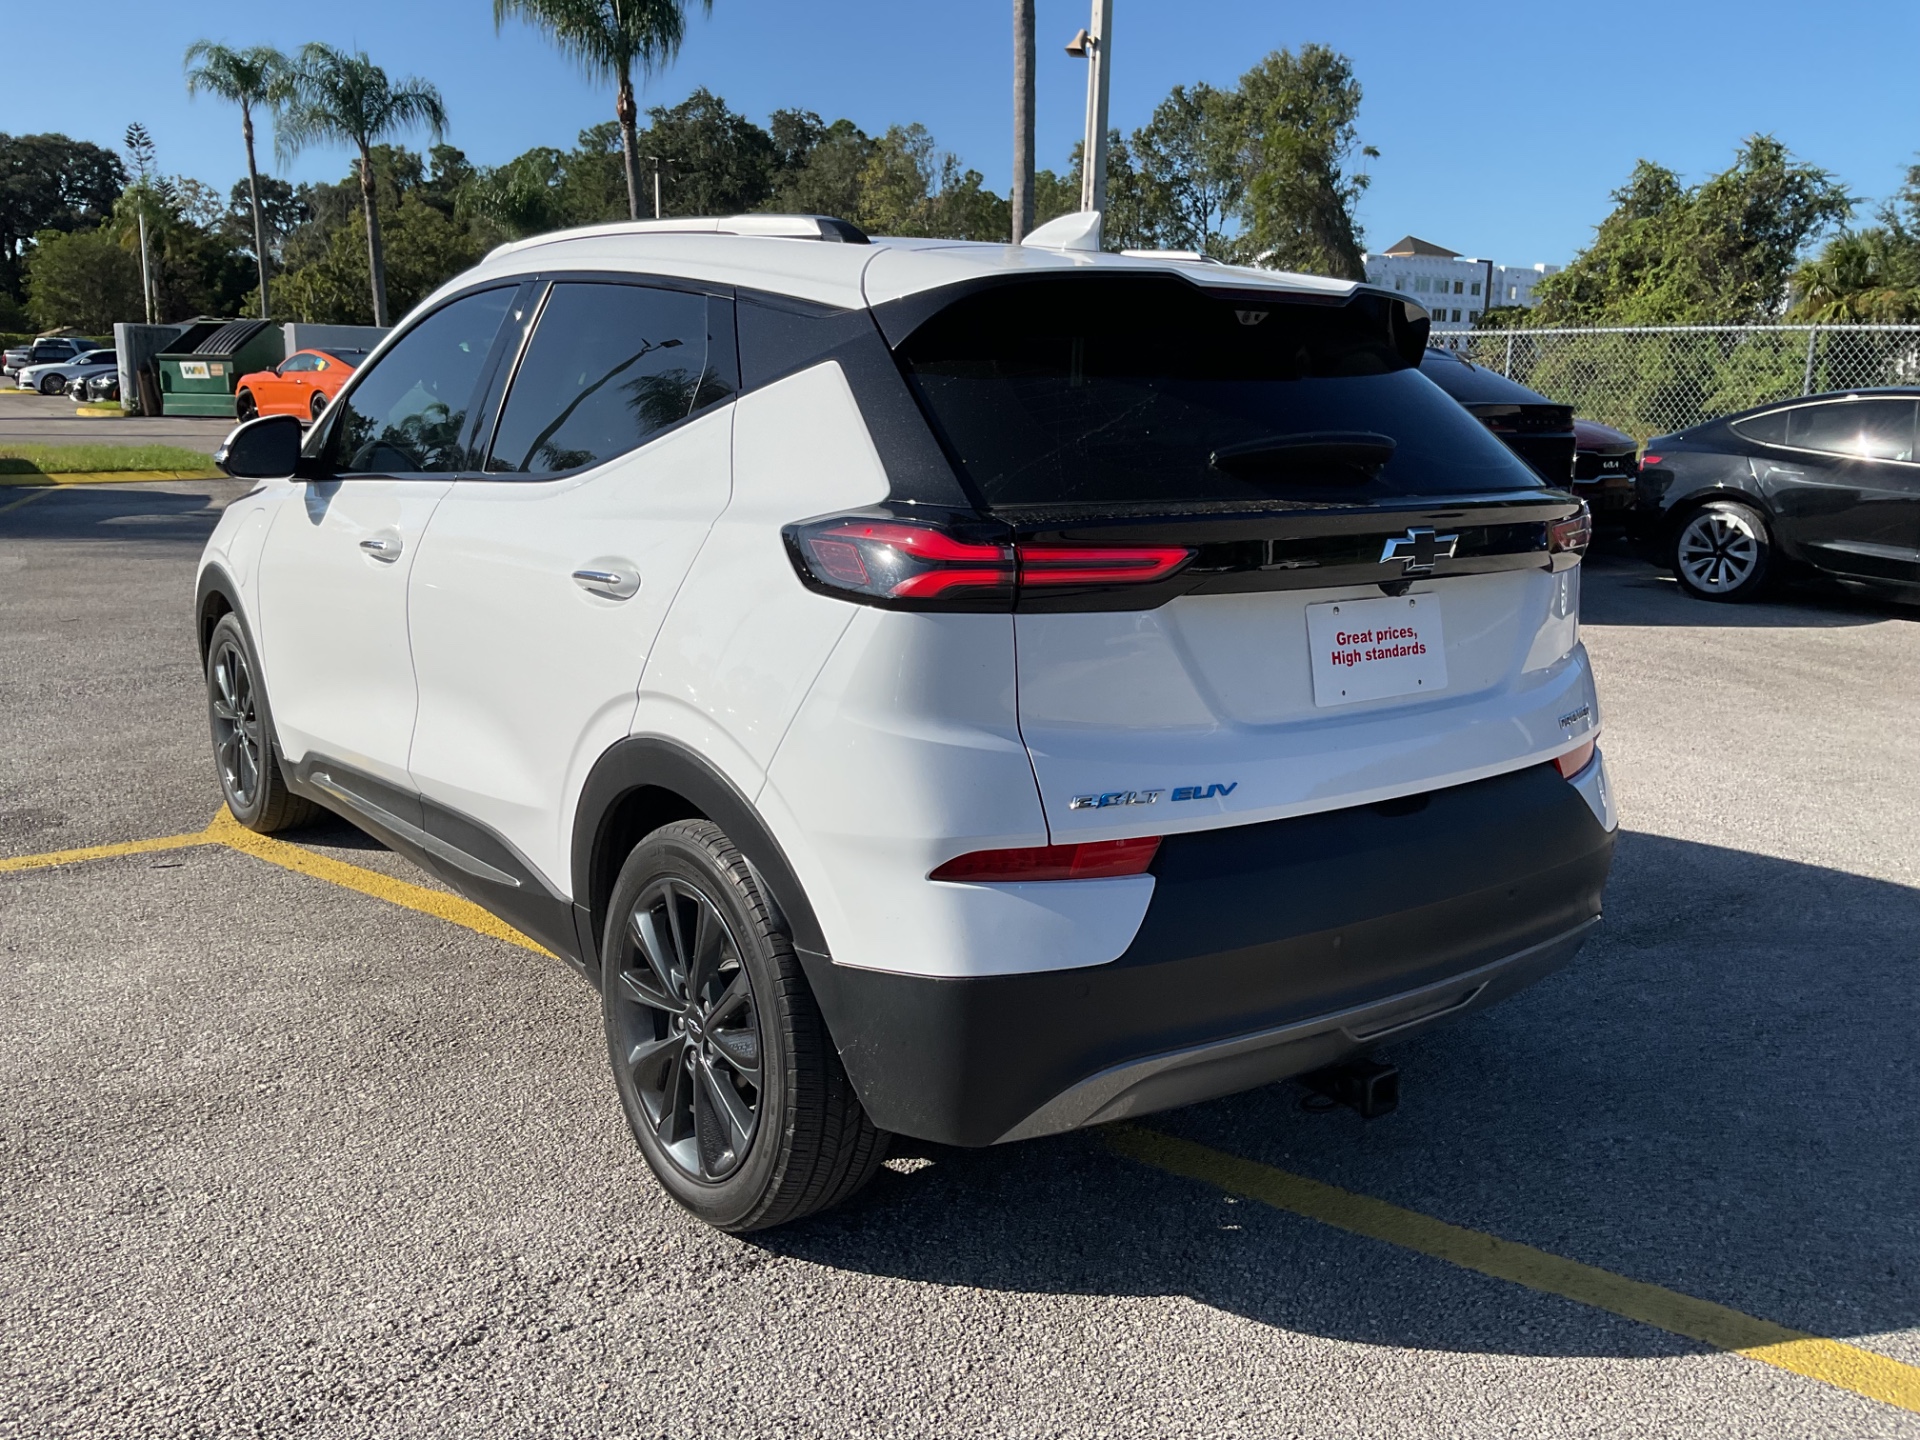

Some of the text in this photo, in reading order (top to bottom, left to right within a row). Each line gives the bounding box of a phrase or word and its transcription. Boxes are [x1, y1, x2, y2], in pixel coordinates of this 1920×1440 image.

[184, 366, 205, 375] WM
[1336, 626, 1418, 646] Great prices,
[1331, 642, 1427, 667] High standards
[1171, 781, 1238, 802] EUV
